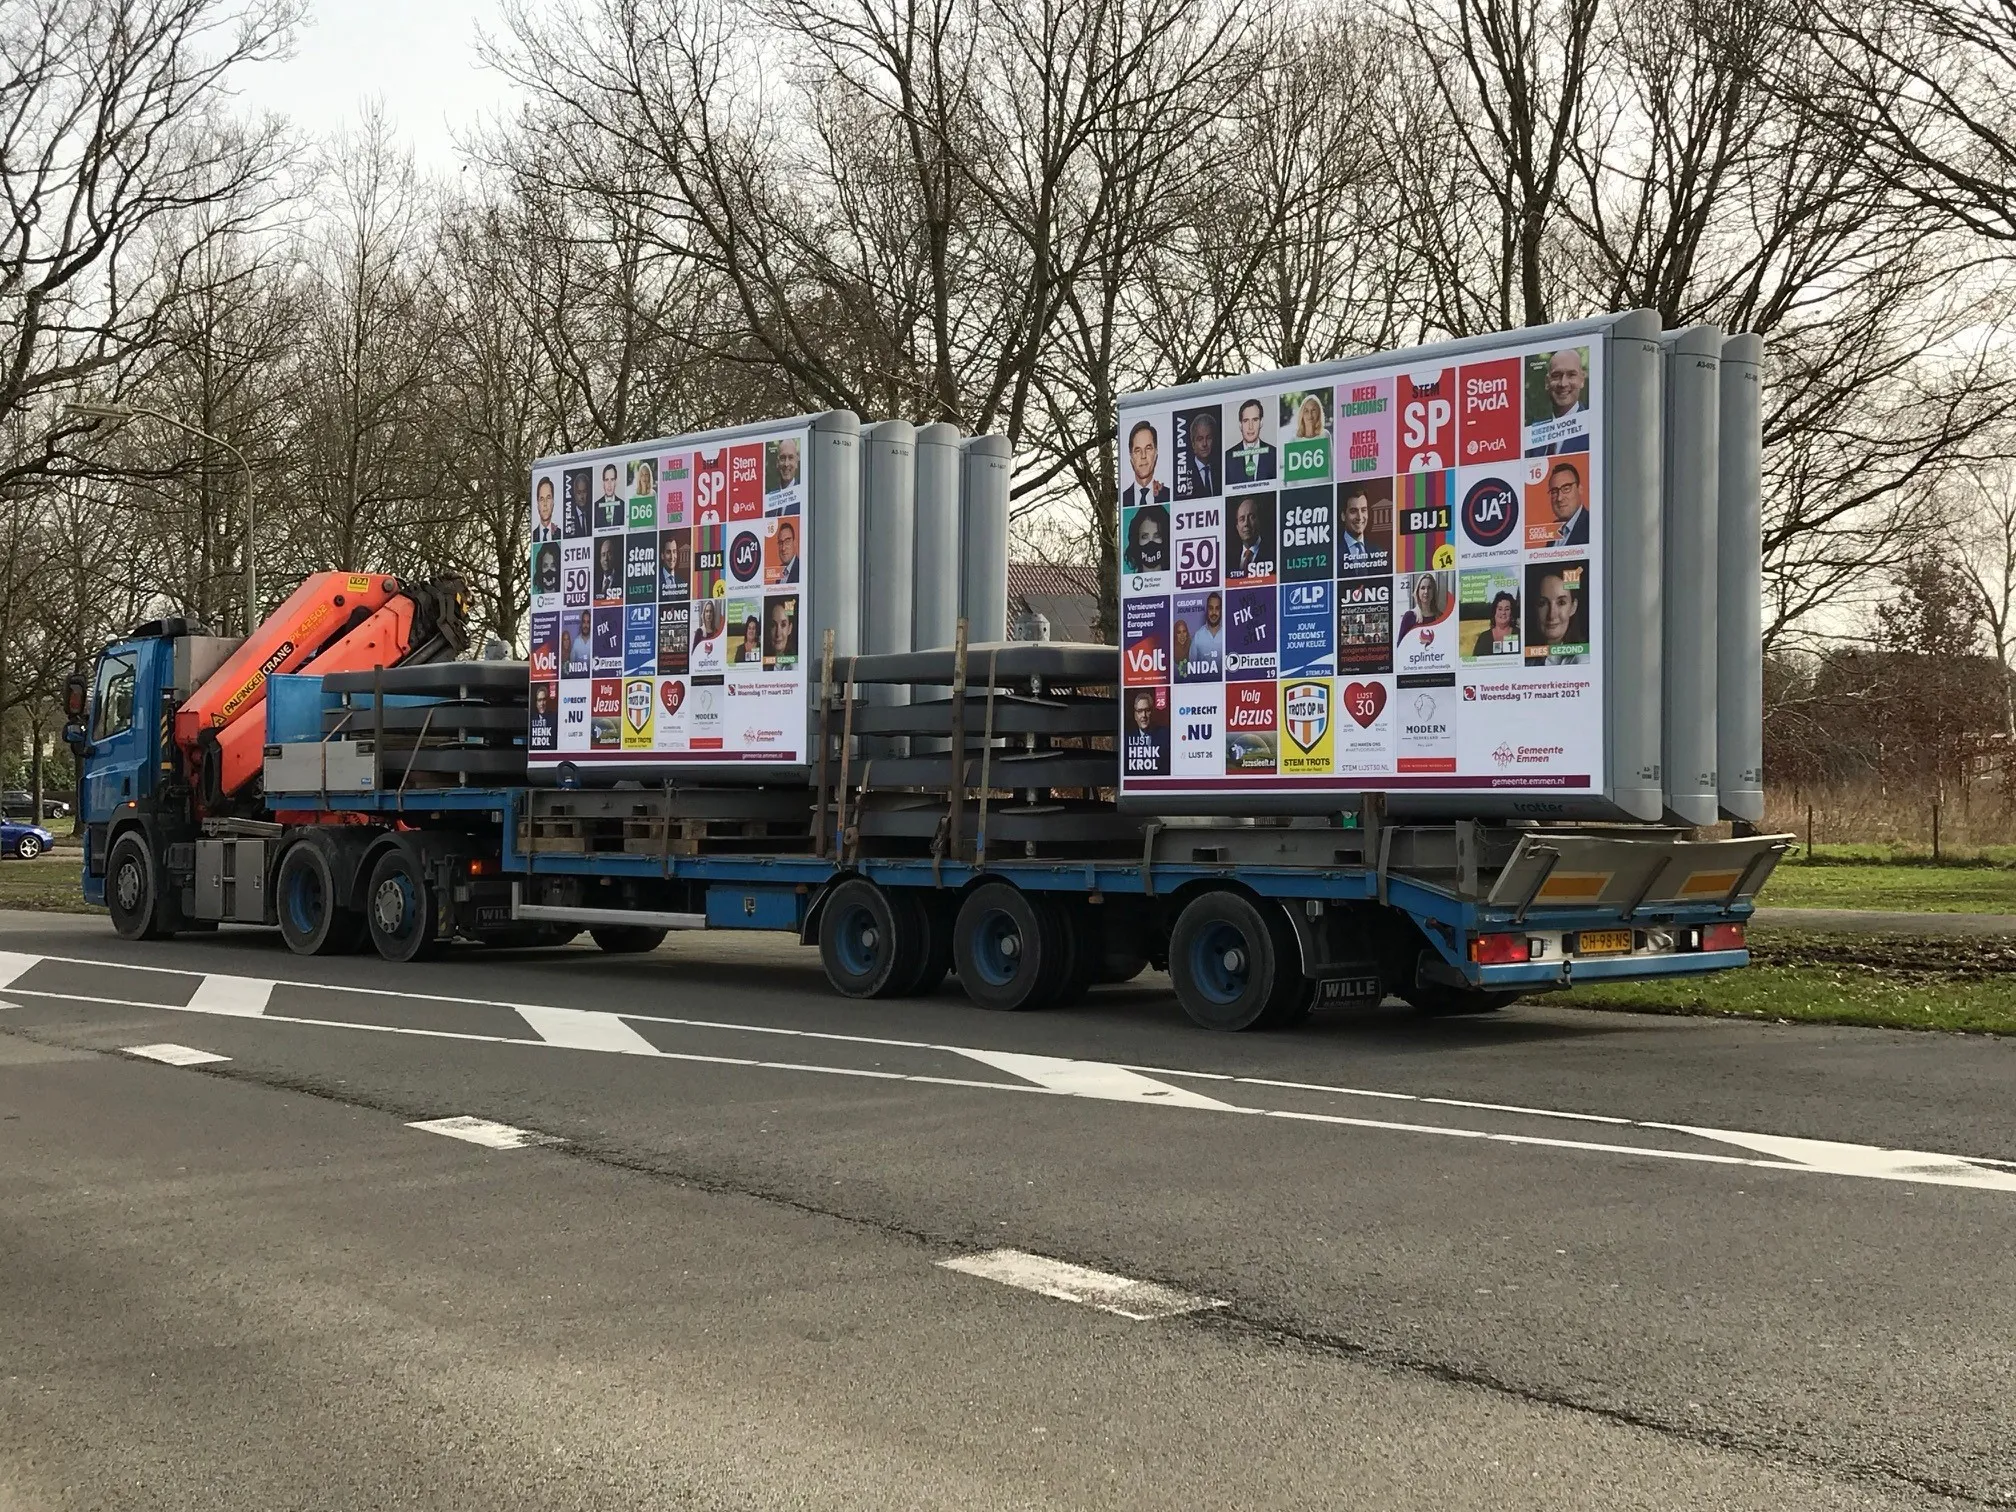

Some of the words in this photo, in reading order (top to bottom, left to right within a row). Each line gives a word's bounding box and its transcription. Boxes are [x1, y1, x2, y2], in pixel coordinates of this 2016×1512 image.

[1352, 386, 1376, 402] MEER
[1412, 382, 1440, 398] STEM
[1467, 378, 1508, 396] Stem
[1341, 398, 1388, 418] TOEKOMST
[1467, 392, 1510, 414] PvdA
[1404, 400, 1450, 448] SP
[1532, 426, 1555, 436] KIEZEN
[1556, 419, 1576, 430] VOOR
[1176, 418, 1187, 448] PVV
[1352, 429, 1376, 446] MEER
[1532, 436, 1547, 444] WAT
[1566, 425, 1582, 434] TELT
[1350, 443, 1378, 460] GROEN
[1480, 438, 1506, 452] PvdA
[733, 457, 756, 470] Stem
[1288, 449, 1324, 471] D66
[1352, 458, 1377, 473] LINKS
[733, 468, 757, 482] PvdA
[1177, 451, 1187, 493] STEM
[1530, 468, 1542, 480] 16
[698, 470, 724, 507] SP
[631, 504, 652, 520] D66
[740, 502, 756, 512] PvdA
[1176, 510, 1220, 530] STEM
[1286, 505, 1328, 526] stem
[1410, 510, 1448, 531] BIJ1
[1283, 524, 1330, 548] DENK
[564, 546, 590, 562] STEM
[629, 546, 654, 562] stem
[700, 553, 722, 568] BIJ1
[1142, 552, 1156, 562] Plan
[1156, 550, 1162, 560] B
[1180, 540, 1214, 570] 50
[1344, 551, 1368, 562] Forum
[1370, 550, 1388, 559] voor
[1439, 554, 1453, 569] 14
[628, 561, 655, 578] DENK
[1230, 570, 1244, 578] STEM
[1247, 560, 1274, 578] SGP
[1286, 557, 1314, 570] LIJST
[1315, 554, 1327, 568] 12
[1344, 558, 1388, 570] Democratie
[566, 570, 586, 592] 50
[1180, 570, 1212, 585] PLUS
[606, 587, 622, 600] SGP
[1400, 582, 1410, 590] 22
[566, 594, 586, 604] PLUS
[1302, 586, 1324, 604] LP
[1341, 586, 1389, 604] JONG
[660, 609, 688, 622] JONG
[1233, 606, 1253, 626] FIX
[597, 622, 609, 636] FIX
[1127, 620, 1154, 629] Europees
[262, 644, 292, 674] CRANE
[301, 604, 328, 632] 42502
[1255, 624, 1266, 641] IT
[1288, 630, 1325, 640] TOEKOMST
[609, 635, 617, 648] IT
[1287, 641, 1305, 650] JOUW
[1306, 640, 1326, 648] KEUZE
[1508, 642, 1512, 651] 1
[1409, 652, 1444, 664] splinter
[1530, 647, 1548, 656] KIES
[1551, 645, 1583, 654] GEZOND
[533, 652, 557, 670] Volt
[569, 662, 588, 672] NIDA
[601, 660, 622, 668] Piraten
[1128, 648, 1166, 672] Volt
[1187, 660, 1218, 675] NIDA
[1241, 656, 1275, 667] Piraten
[1266, 669, 1276, 678] 19
[600, 685, 613, 696] Volg
[1512, 681, 1590, 690] Kamerverkiezingen
[667, 694, 678, 706] 30
[1241, 690, 1261, 704] Volg
[1480, 693, 1520, 701] Woensdag
[1535, 691, 1559, 699] maart
[1561, 690, 1580, 698] 2021
[593, 696, 620, 712] Jezus
[1179, 706, 1217, 715] OPRECHT
[1288, 702, 1306, 716] TROTS
[1308, 702, 1316, 715] OP
[1317, 703, 1325, 714] NL
[1356, 700, 1375, 716] 30
[1230, 706, 1273, 726] Jezus
[532, 727, 551, 736] HENK
[1406, 724, 1446, 734] MODERN
[532, 737, 550, 746] KROL
[1128, 736, 1149, 746] LIJST
[1128, 746, 1160, 758] HENK
[1518, 746, 1564, 755] Gemeente
[1128, 759, 1158, 770] KROL
[1306, 758, 1330, 766] TROTS
[1492, 777, 1565, 787] gemeente.emmen.nl
[1581, 932, 1629, 950] OH-98-NS
[1326, 981, 1376, 998] WILLE
